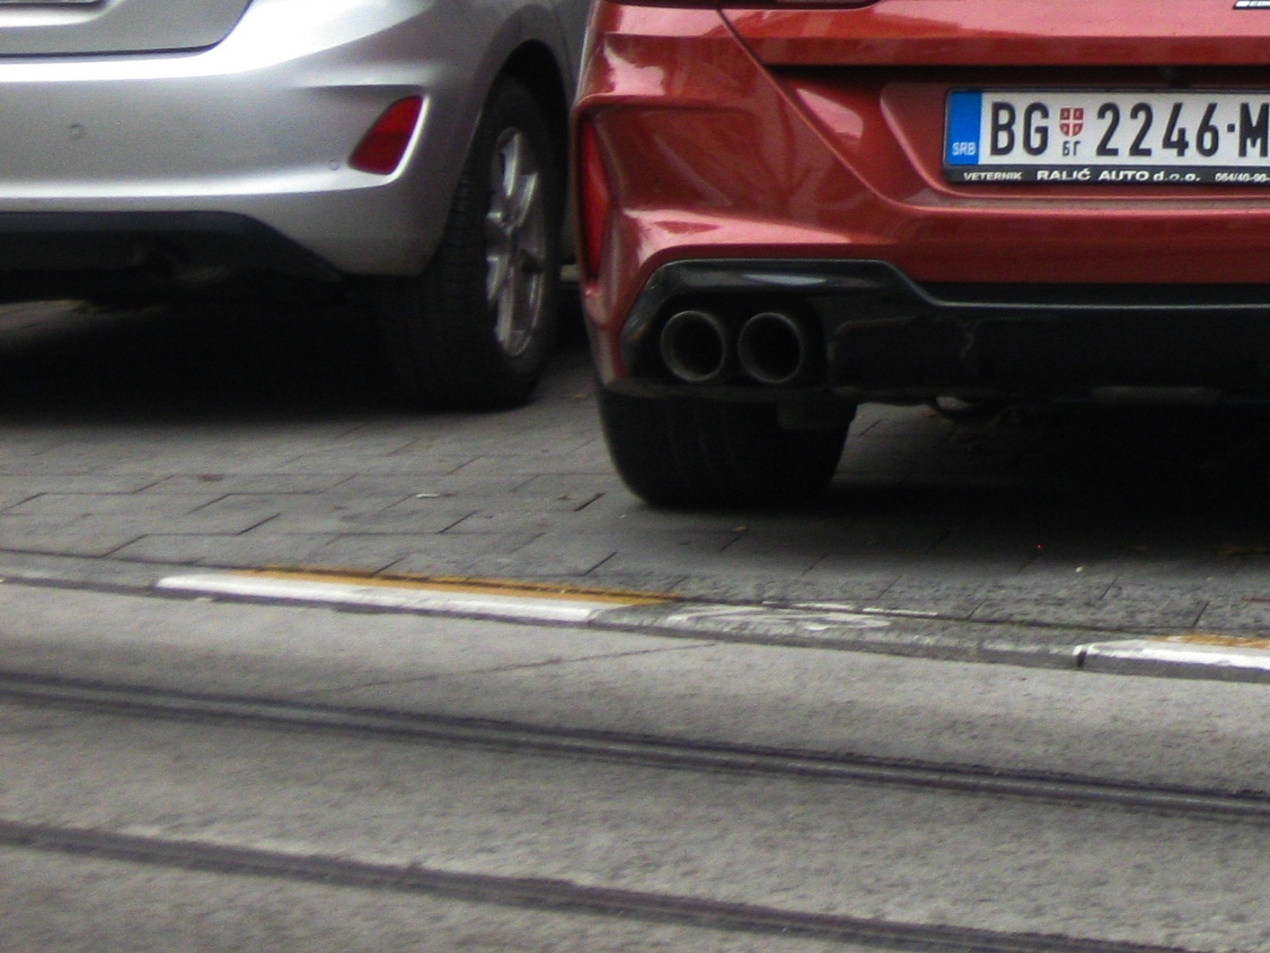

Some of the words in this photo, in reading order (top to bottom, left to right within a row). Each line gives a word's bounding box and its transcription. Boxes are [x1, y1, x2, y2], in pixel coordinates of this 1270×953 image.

[990, 101, 1050, 156] BG
[952, 141, 977, 155] SRB
[963, 171, 1023, 181] VETERNIK
[1037, 168, 1091, 181] RALIĆ
[1098, 170, 1149, 181] AUTO
[1152, 170, 1200, 181] d.o.o.
